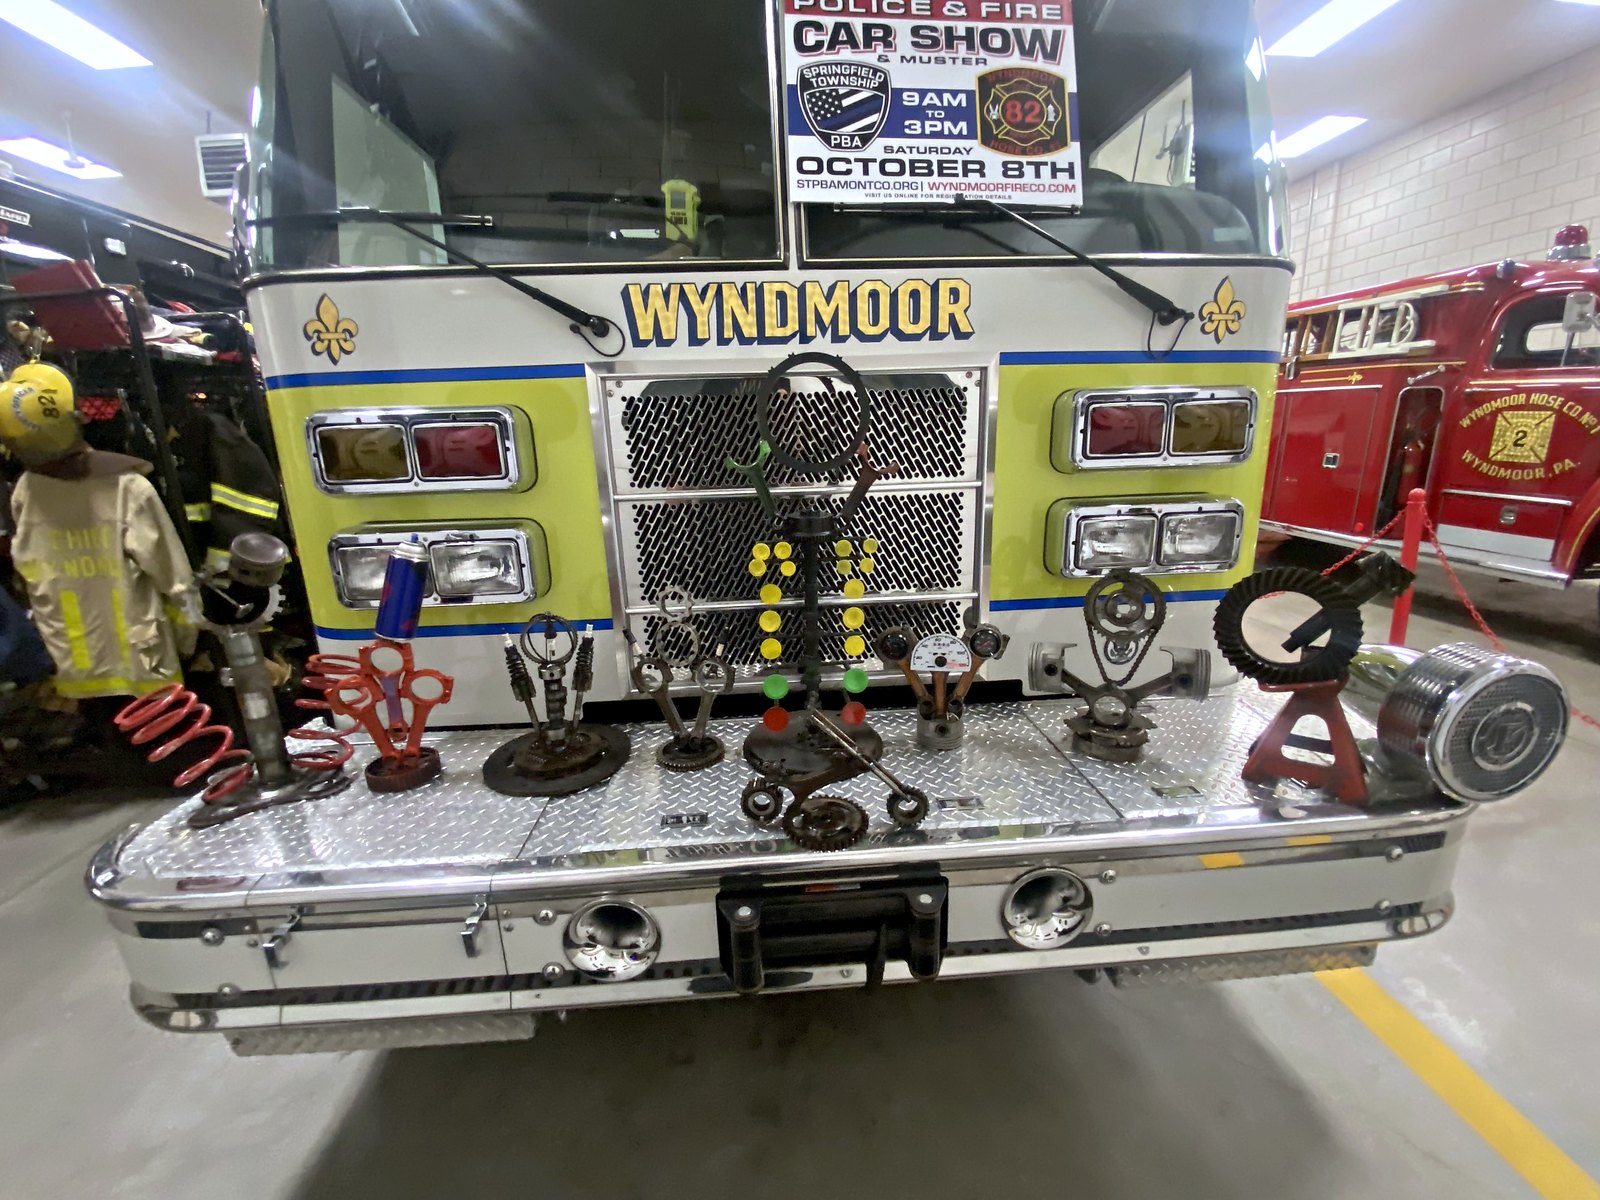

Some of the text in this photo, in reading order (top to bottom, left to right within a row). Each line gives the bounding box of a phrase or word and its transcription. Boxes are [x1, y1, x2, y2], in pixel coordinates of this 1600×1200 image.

[794, 0, 1062, 19] POLICE & FIRE
[793, 20, 1066, 65] CAR SHOW
[877, 54, 988, 66] & MUSTER
[803, 64, 884, 82] SPRINGFIELD
[810, 75, 879, 89] TOWNSHIP
[902, 91, 967, 107] 9AM
[925, 110, 945, 118] TO
[1005, 99, 1042, 124] 82
[904, 120, 968, 136] 3PM
[831, 135, 862, 148] PBA
[883, 145, 973, 155] SATURDAY
[796, 156, 1076, 180] OCTOBER 8TH
[796, 179, 919, 191] STPBAMONTCO.ORG
[927, 182, 1077, 193] WYNDMOORFIRECO.COM
[620, 278, 976, 348] WYNDMOOR
[38, 388, 60, 419] 821
[1459, 393, 1526, 428] WYNDMOOR
[1529, 393, 1565, 410] HOSE
[1512, 430, 1528, 448] 2
